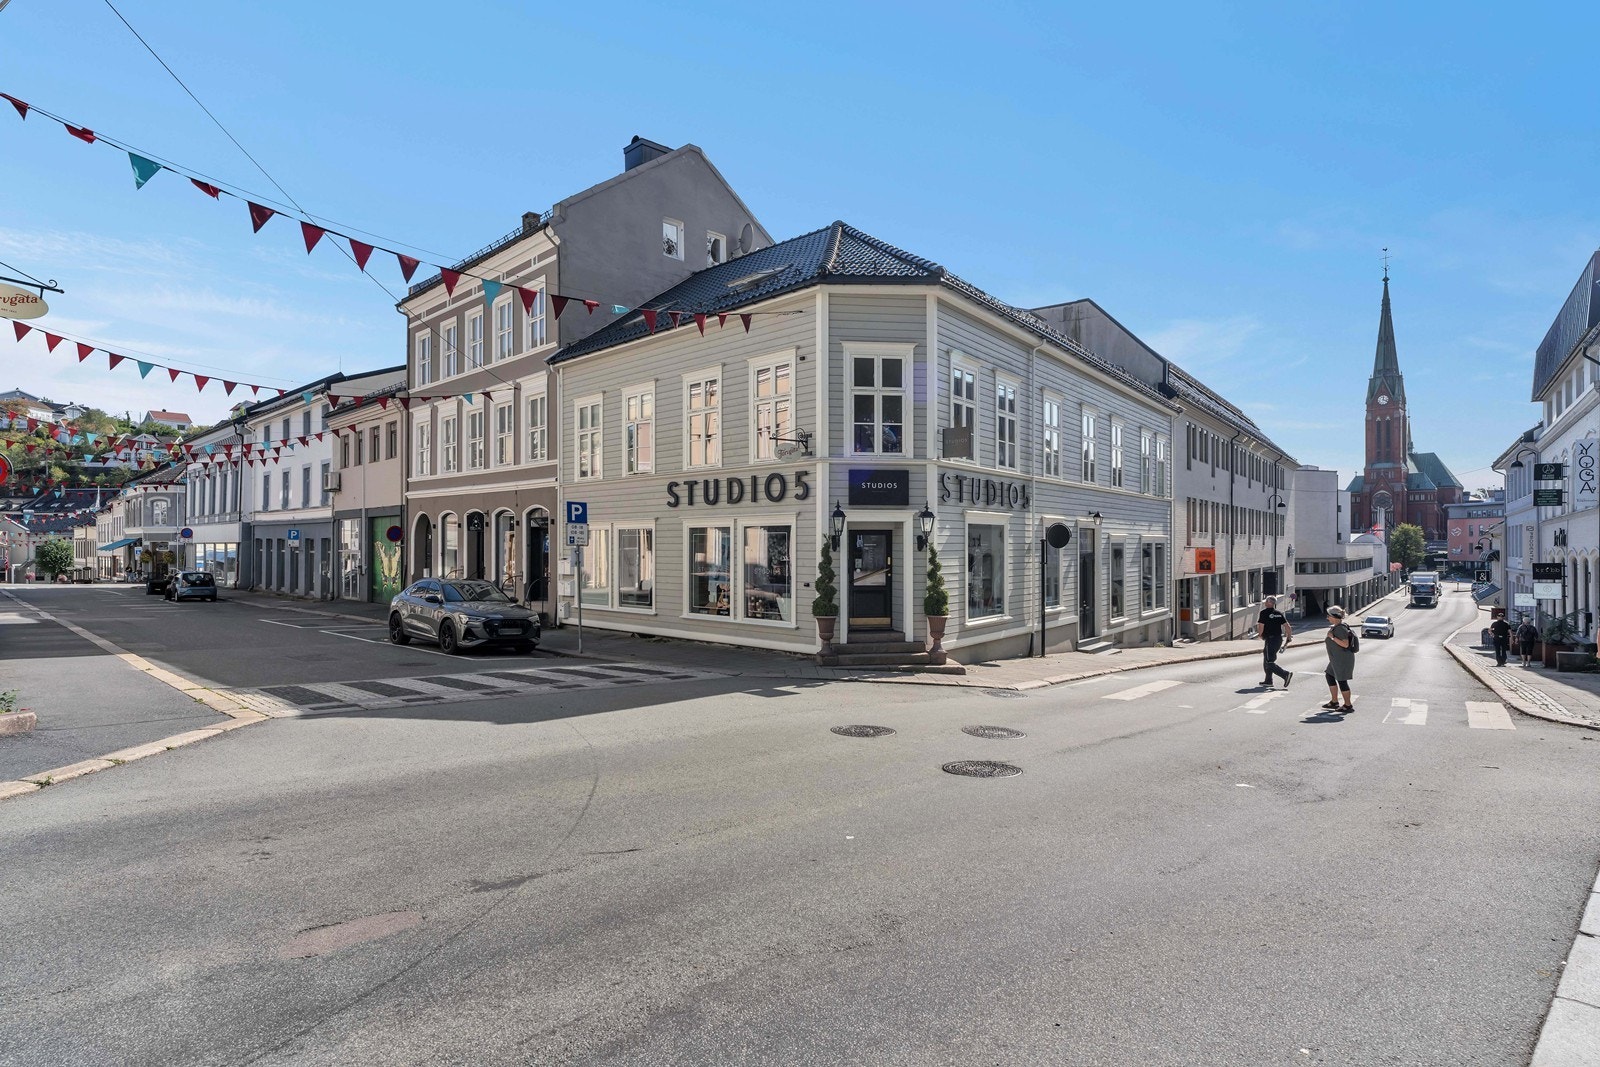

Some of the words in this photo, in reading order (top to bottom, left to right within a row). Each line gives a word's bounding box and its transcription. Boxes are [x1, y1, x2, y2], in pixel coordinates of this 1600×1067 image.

[1579, 443, 1595, 494] YOGA
[666, 470, 809, 508] STUDIO5
[571, 504, 582, 521] P
